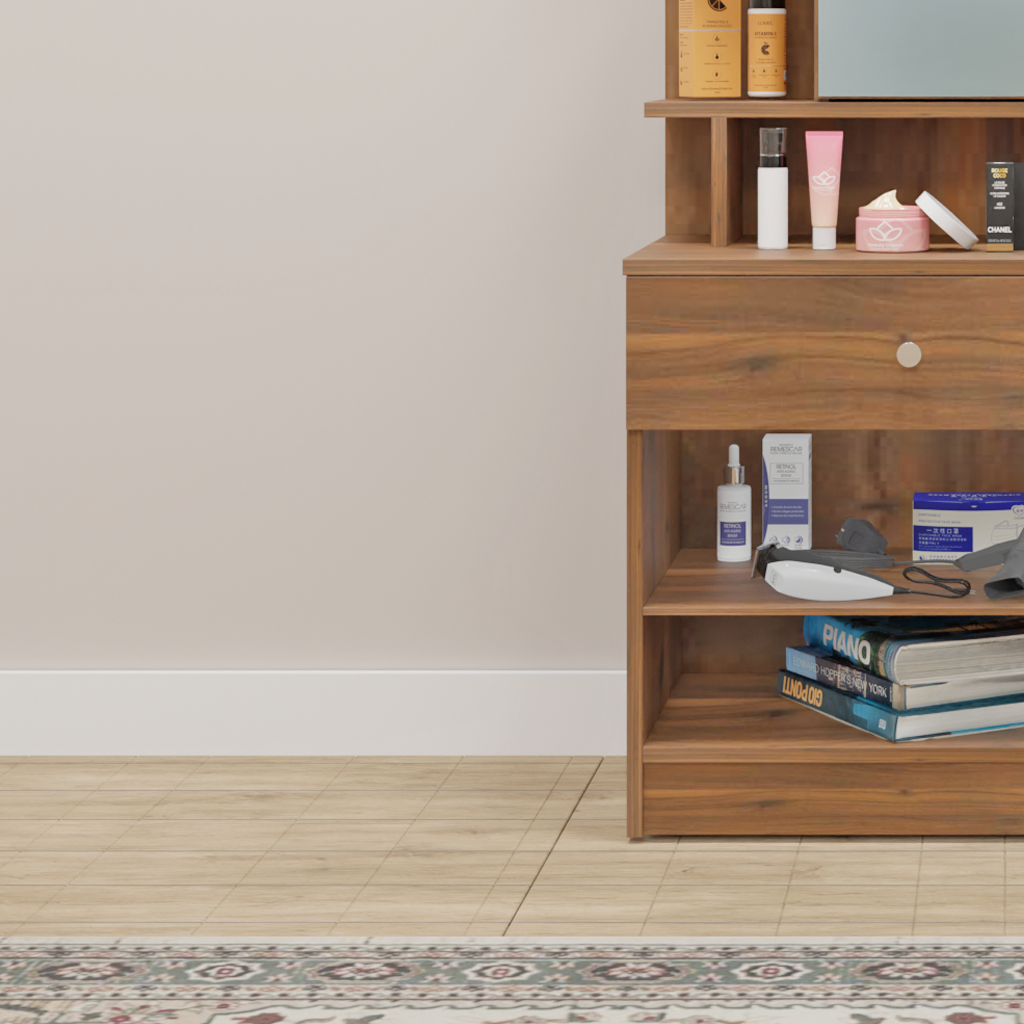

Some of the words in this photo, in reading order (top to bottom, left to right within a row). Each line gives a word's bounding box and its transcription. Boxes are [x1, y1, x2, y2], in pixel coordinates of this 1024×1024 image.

[823, 623, 871, 665] PIANO
[782, 675, 809, 702] PONTI
[793, 656, 819, 673] EDWARD
[820, 666, 851, 685] HOPPER'S
[852, 675, 868, 690] NEW
[869, 682, 887, 698] YORK
[808, 686, 823, 707] GIO
